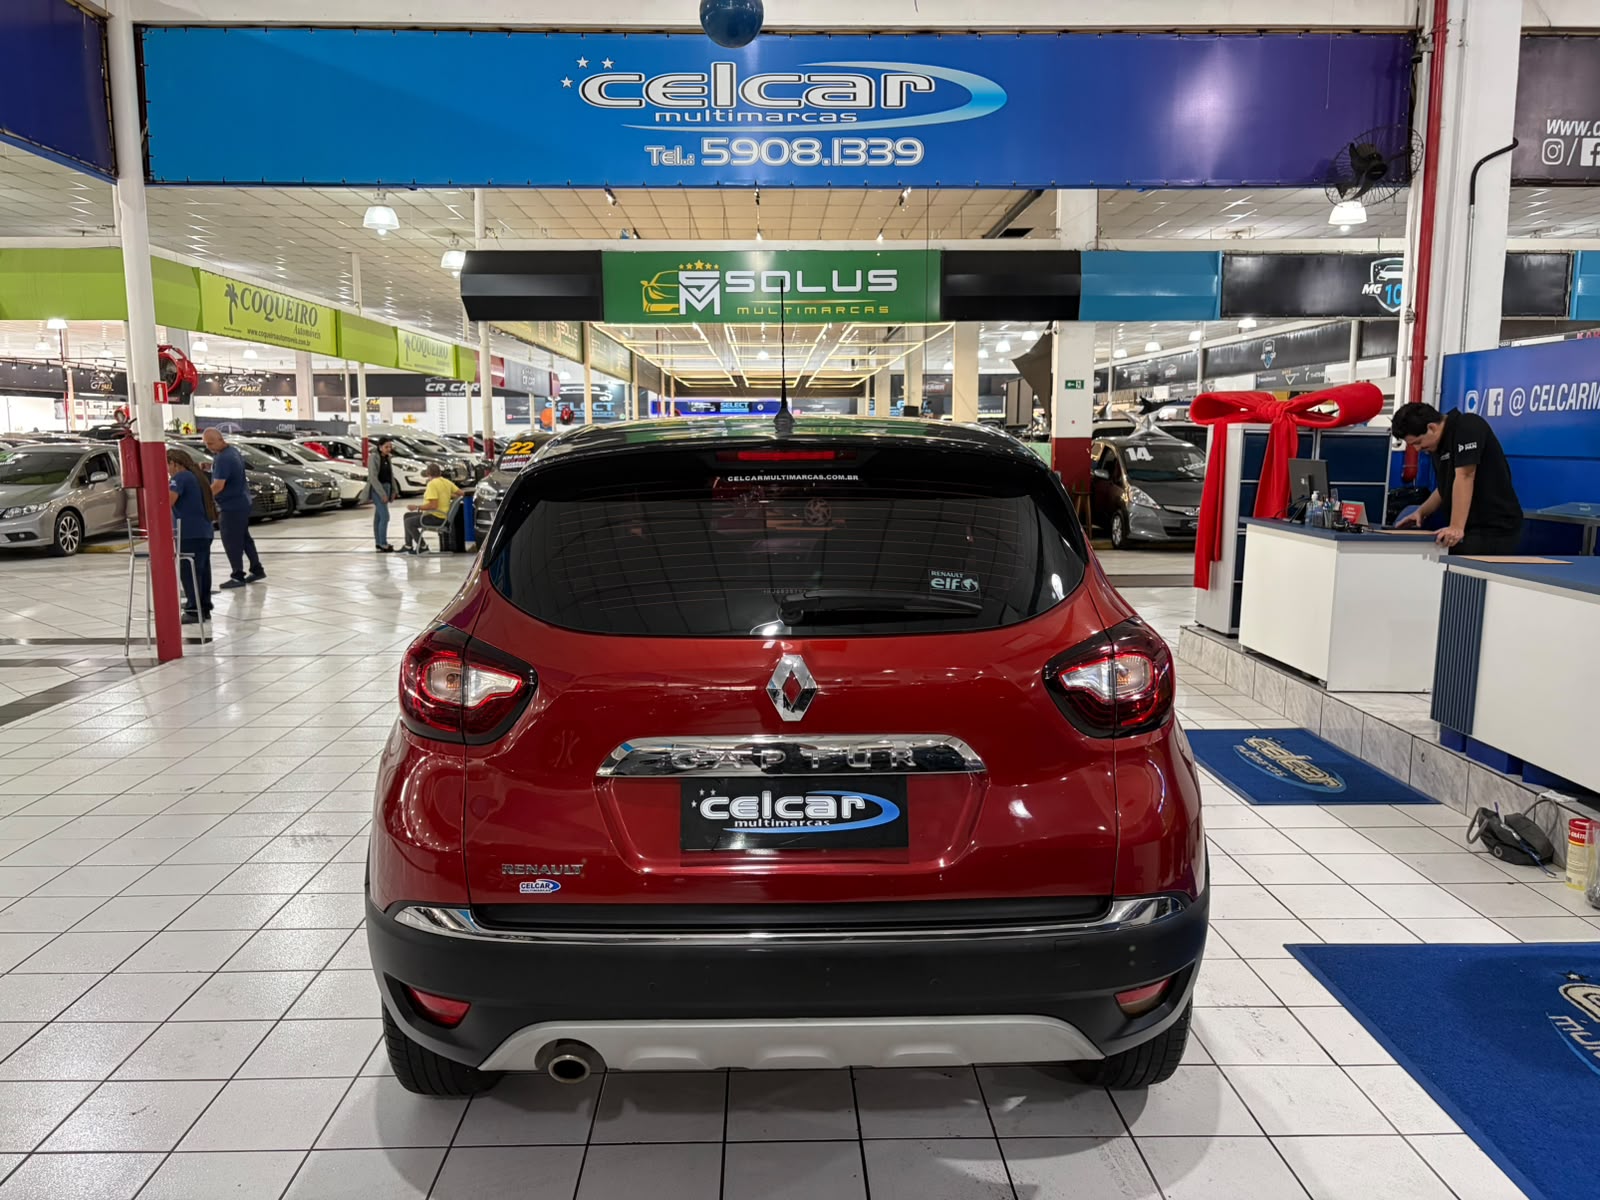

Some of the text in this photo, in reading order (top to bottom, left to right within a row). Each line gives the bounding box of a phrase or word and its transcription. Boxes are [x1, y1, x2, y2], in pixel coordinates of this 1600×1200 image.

[578, 61, 935, 108] celcar
[654, 109, 858, 123] multimarcas
[701, 137, 926, 167] 5908.1339
[725, 269, 898, 292] SOLUS
[1361, 283, 1383, 295] MG
[240, 287, 318, 327] COQUEIRO
[737, 306, 889, 315] MULTIMARCAS
[410, 334, 449, 359] COQUEIRO
[425, 383, 480, 392] CR CAR
[505, 441, 535, 455] 22
[727, 474, 859, 482] CELCARMULTIMARCAS.COM.BR
[931, 570, 964, 578] RENAULT
[699, 790, 867, 820] celcar
[734, 819, 831, 828] multimarcas
[501, 863, 584, 875] RENAULT
